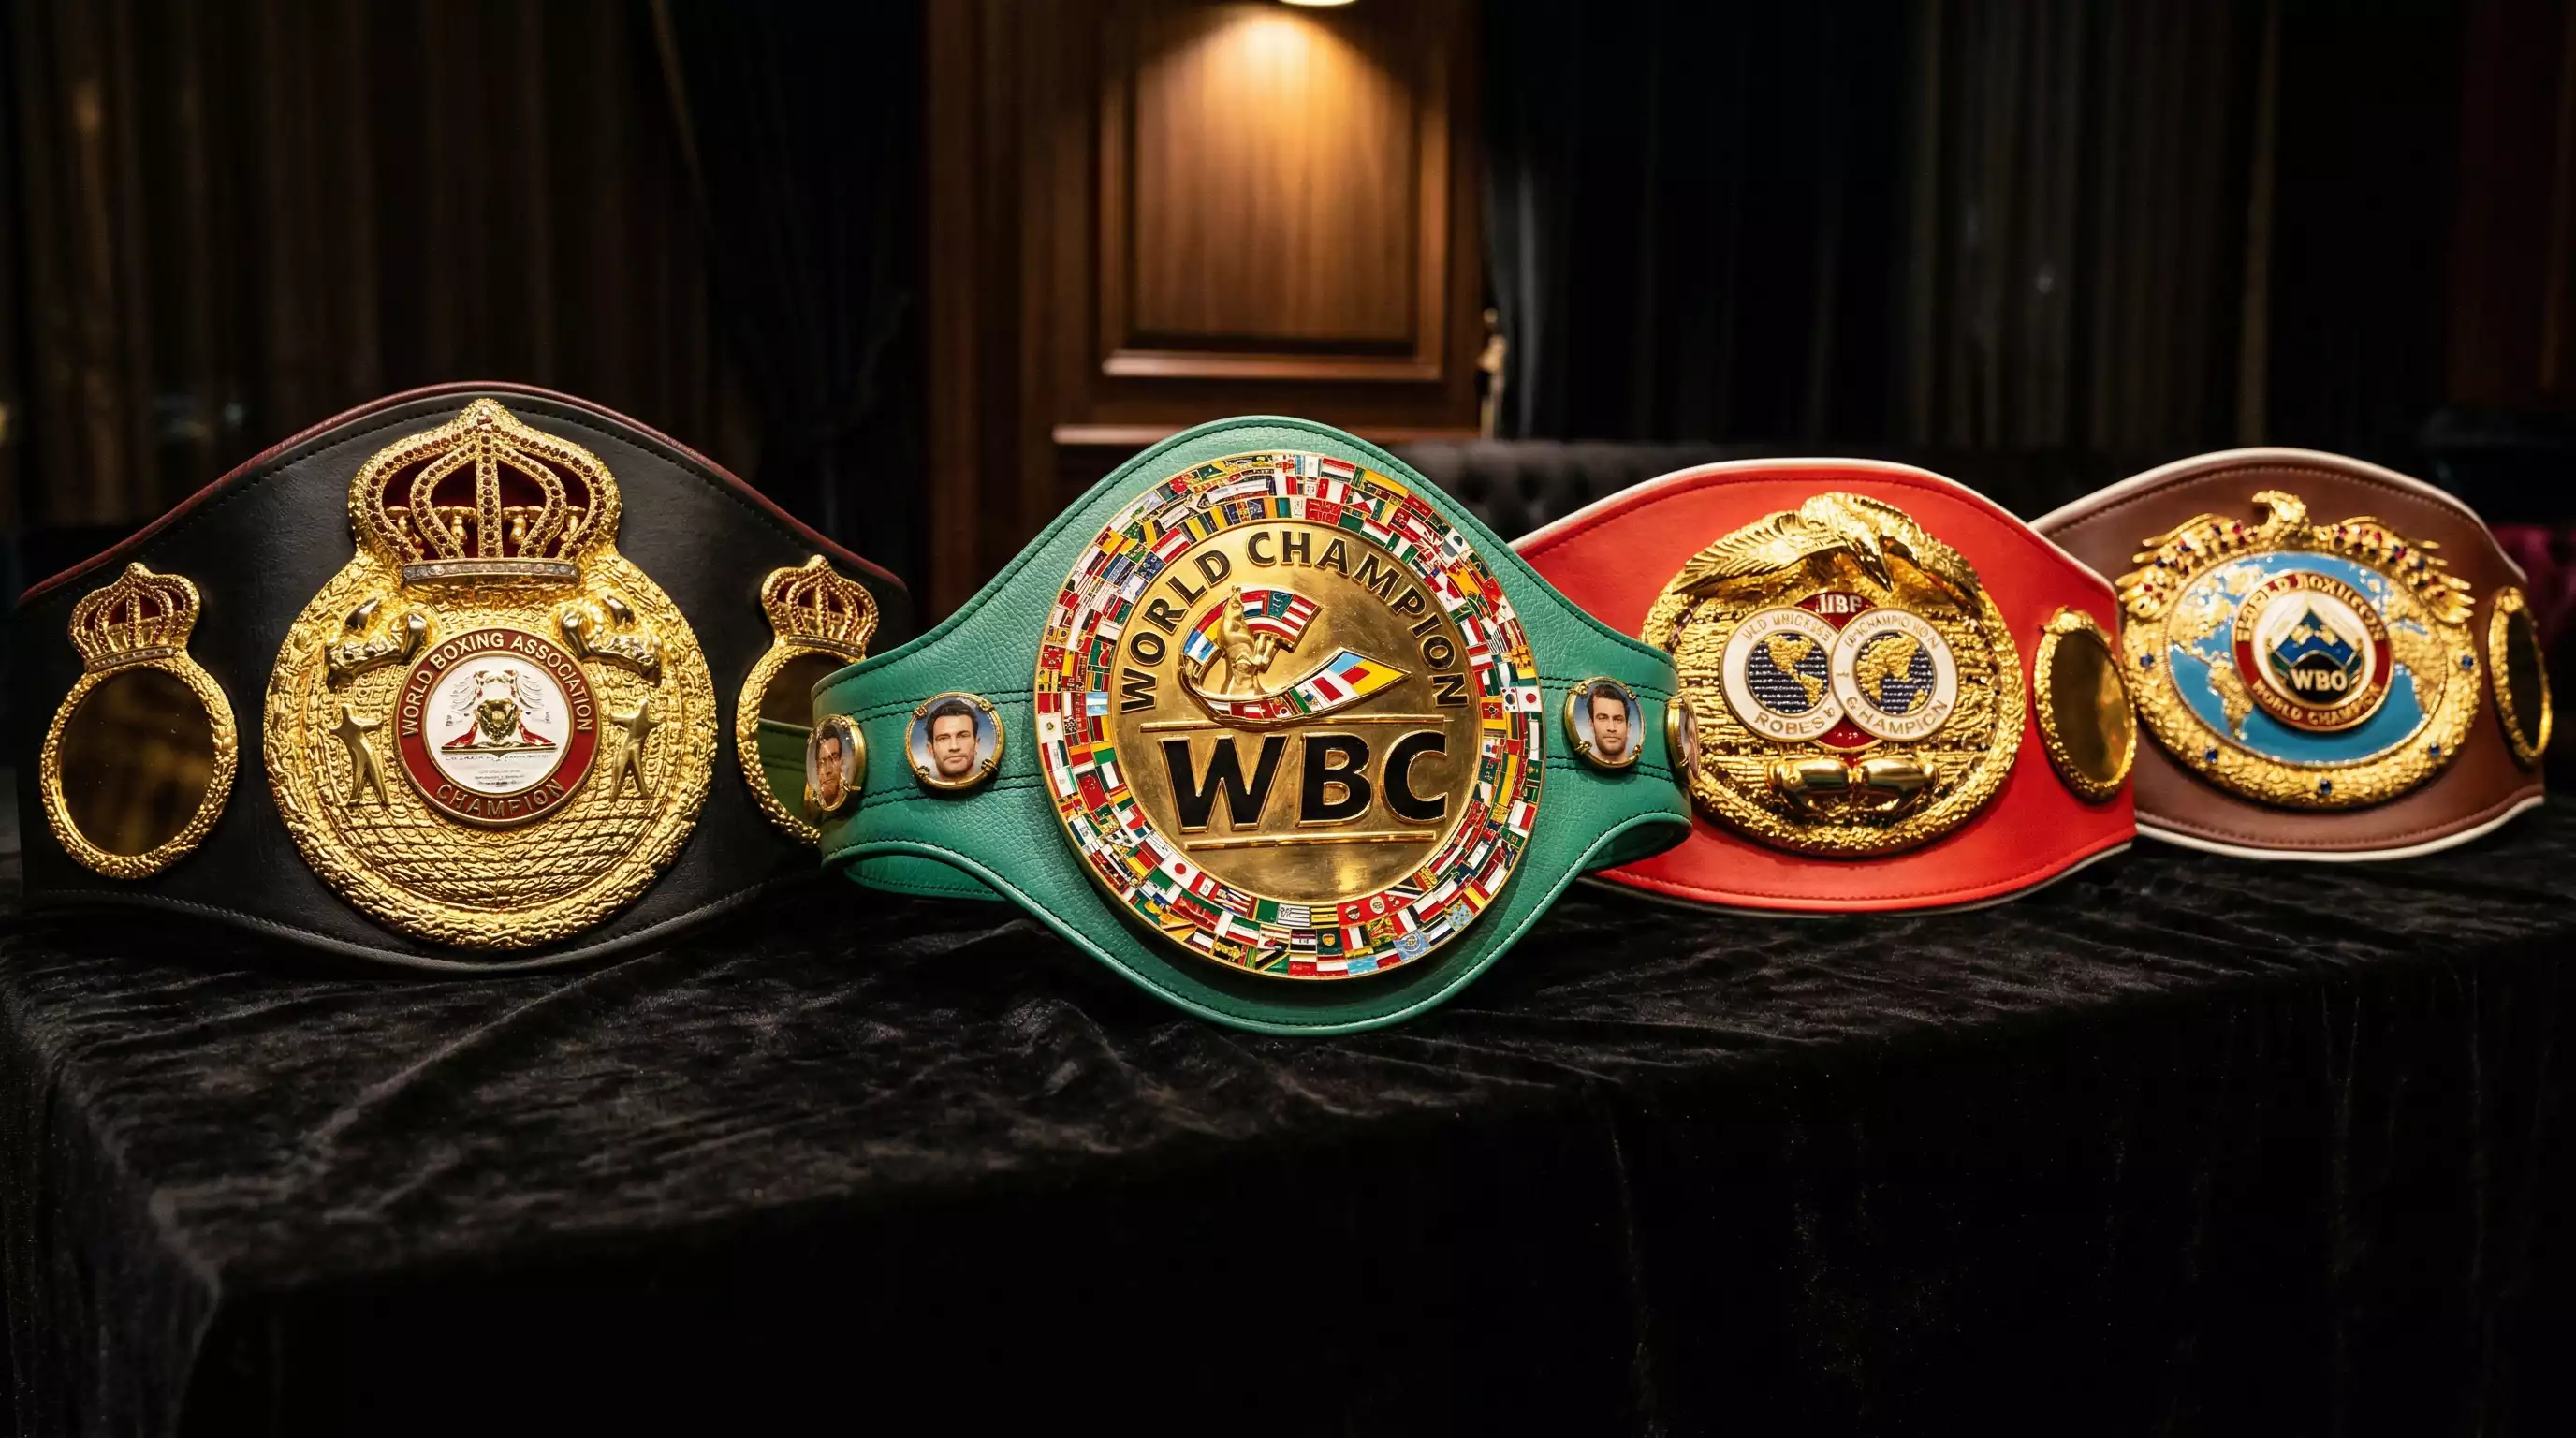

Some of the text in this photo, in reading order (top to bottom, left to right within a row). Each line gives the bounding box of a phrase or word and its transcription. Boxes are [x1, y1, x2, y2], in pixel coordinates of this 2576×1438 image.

[1120, 530, 1470, 714] WORLD CHAMPION
[402, 632, 593, 738] WORLD BOXING ASSOCIATION
[2291, 668, 2348, 691] WBO
[436, 779, 565, 816] CHAMPION
[1158, 729, 1449, 833] WBC
